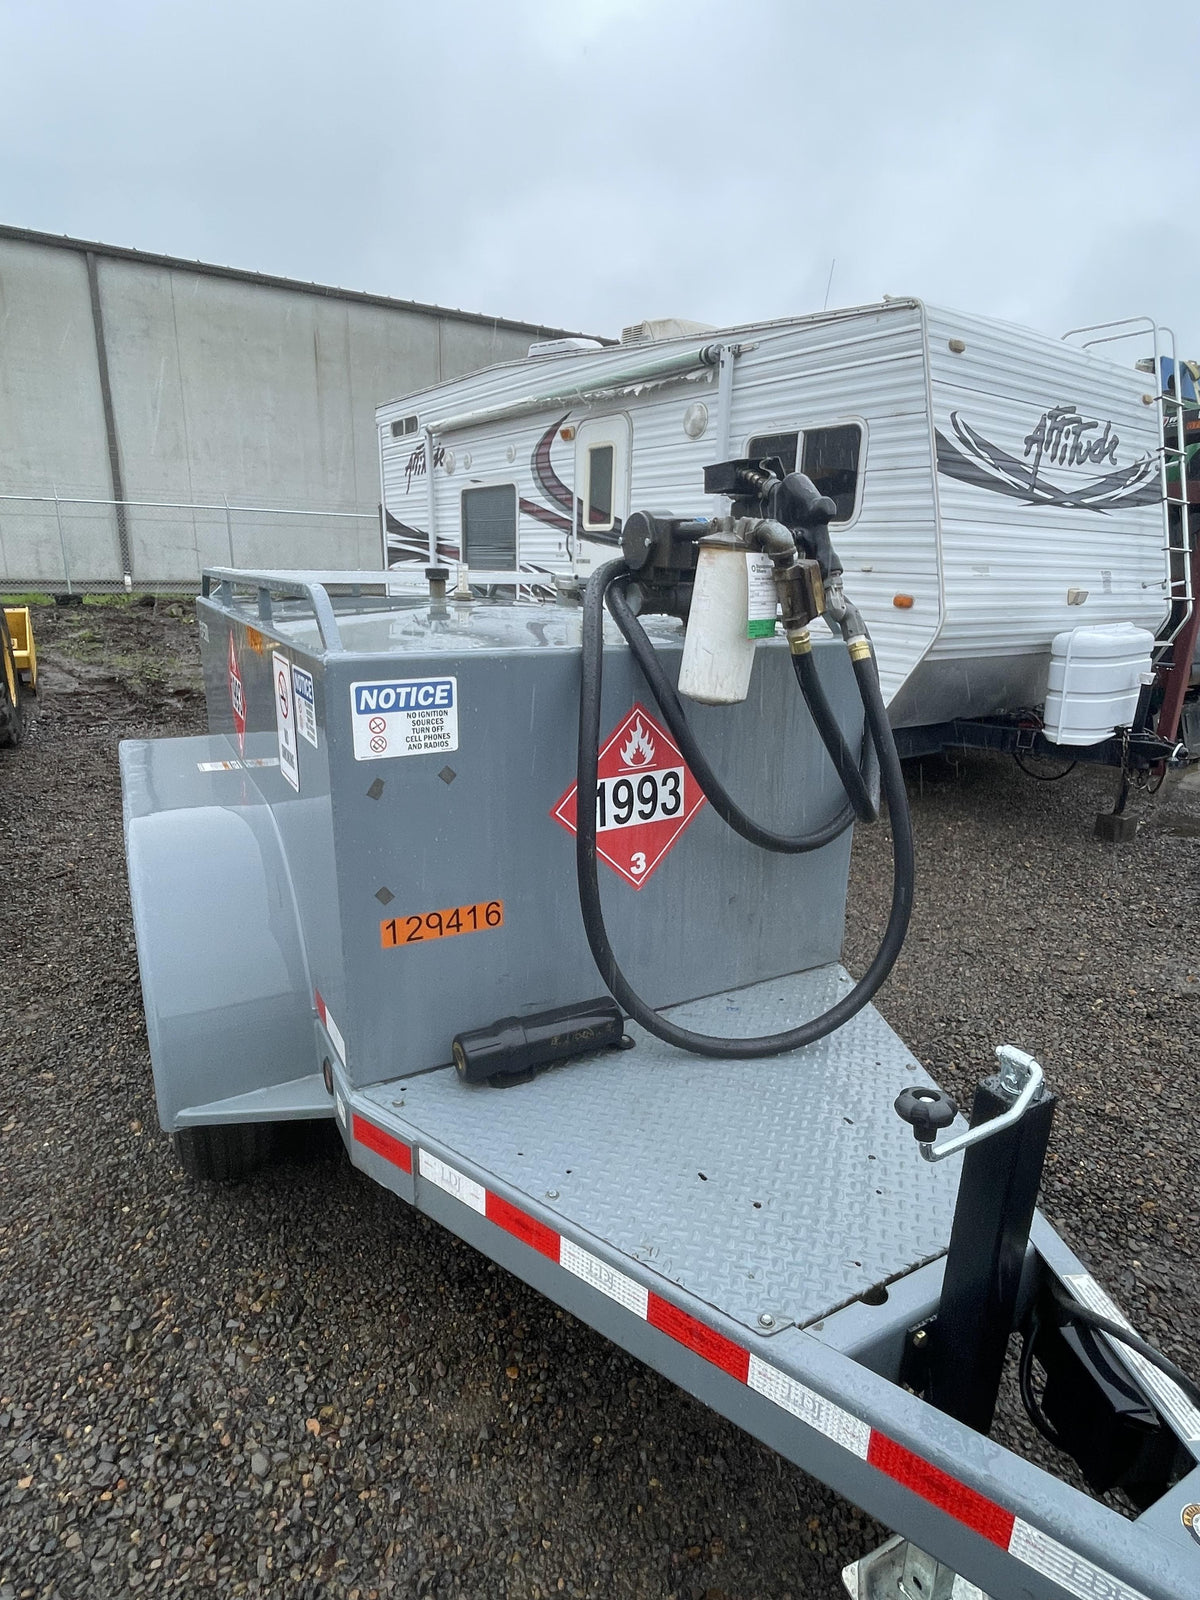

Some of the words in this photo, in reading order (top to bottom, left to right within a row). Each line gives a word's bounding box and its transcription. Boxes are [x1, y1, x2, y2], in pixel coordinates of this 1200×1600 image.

[360, 684, 450, 710] NOTICE
[418, 710, 449, 718] IGNITION
[411, 718, 444, 727] SOURCES
[412, 727, 430, 735] TURN
[423, 733, 451, 742] PHONES
[407, 743, 423, 751] AND
[424, 741, 449, 749] RADIOS
[596, 771, 681, 827] 1993
[630, 852, 647, 874] 3
[386, 902, 501, 945] 129416
